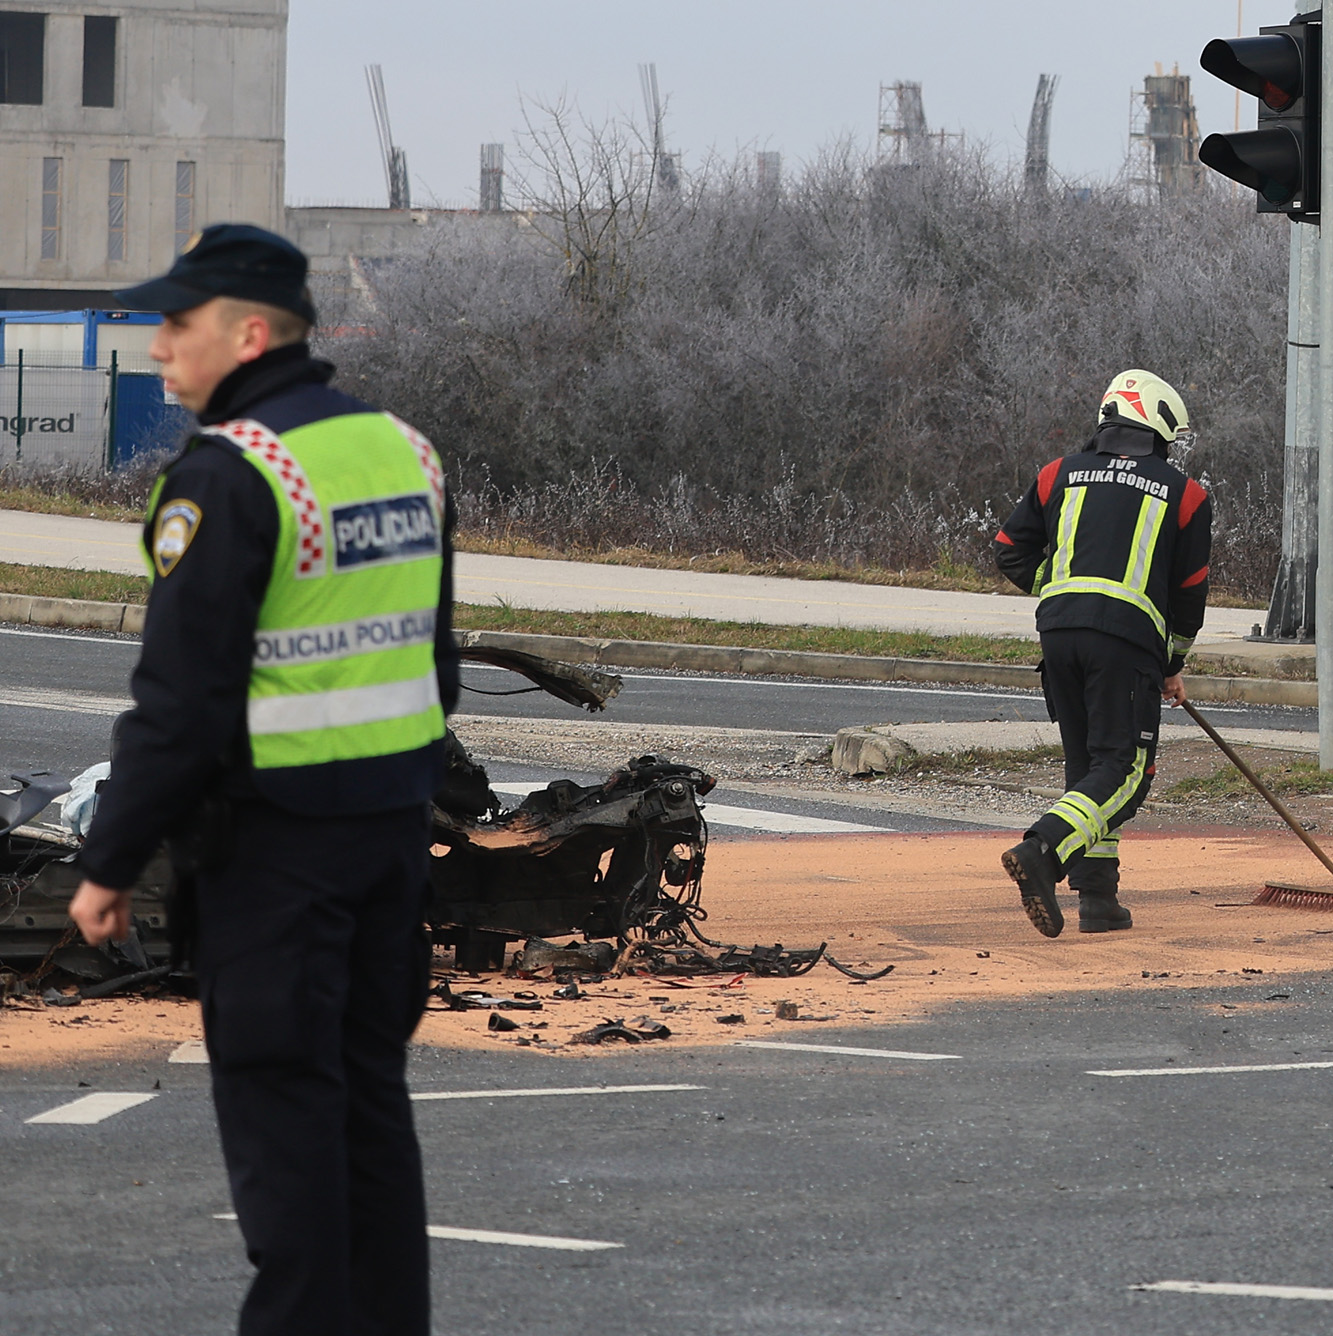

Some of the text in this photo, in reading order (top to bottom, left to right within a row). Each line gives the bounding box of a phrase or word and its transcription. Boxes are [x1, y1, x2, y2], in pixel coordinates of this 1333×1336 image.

[1107, 459, 1137, 471] JVP
[1068, 470, 1169, 500] VELIKA GORICA
